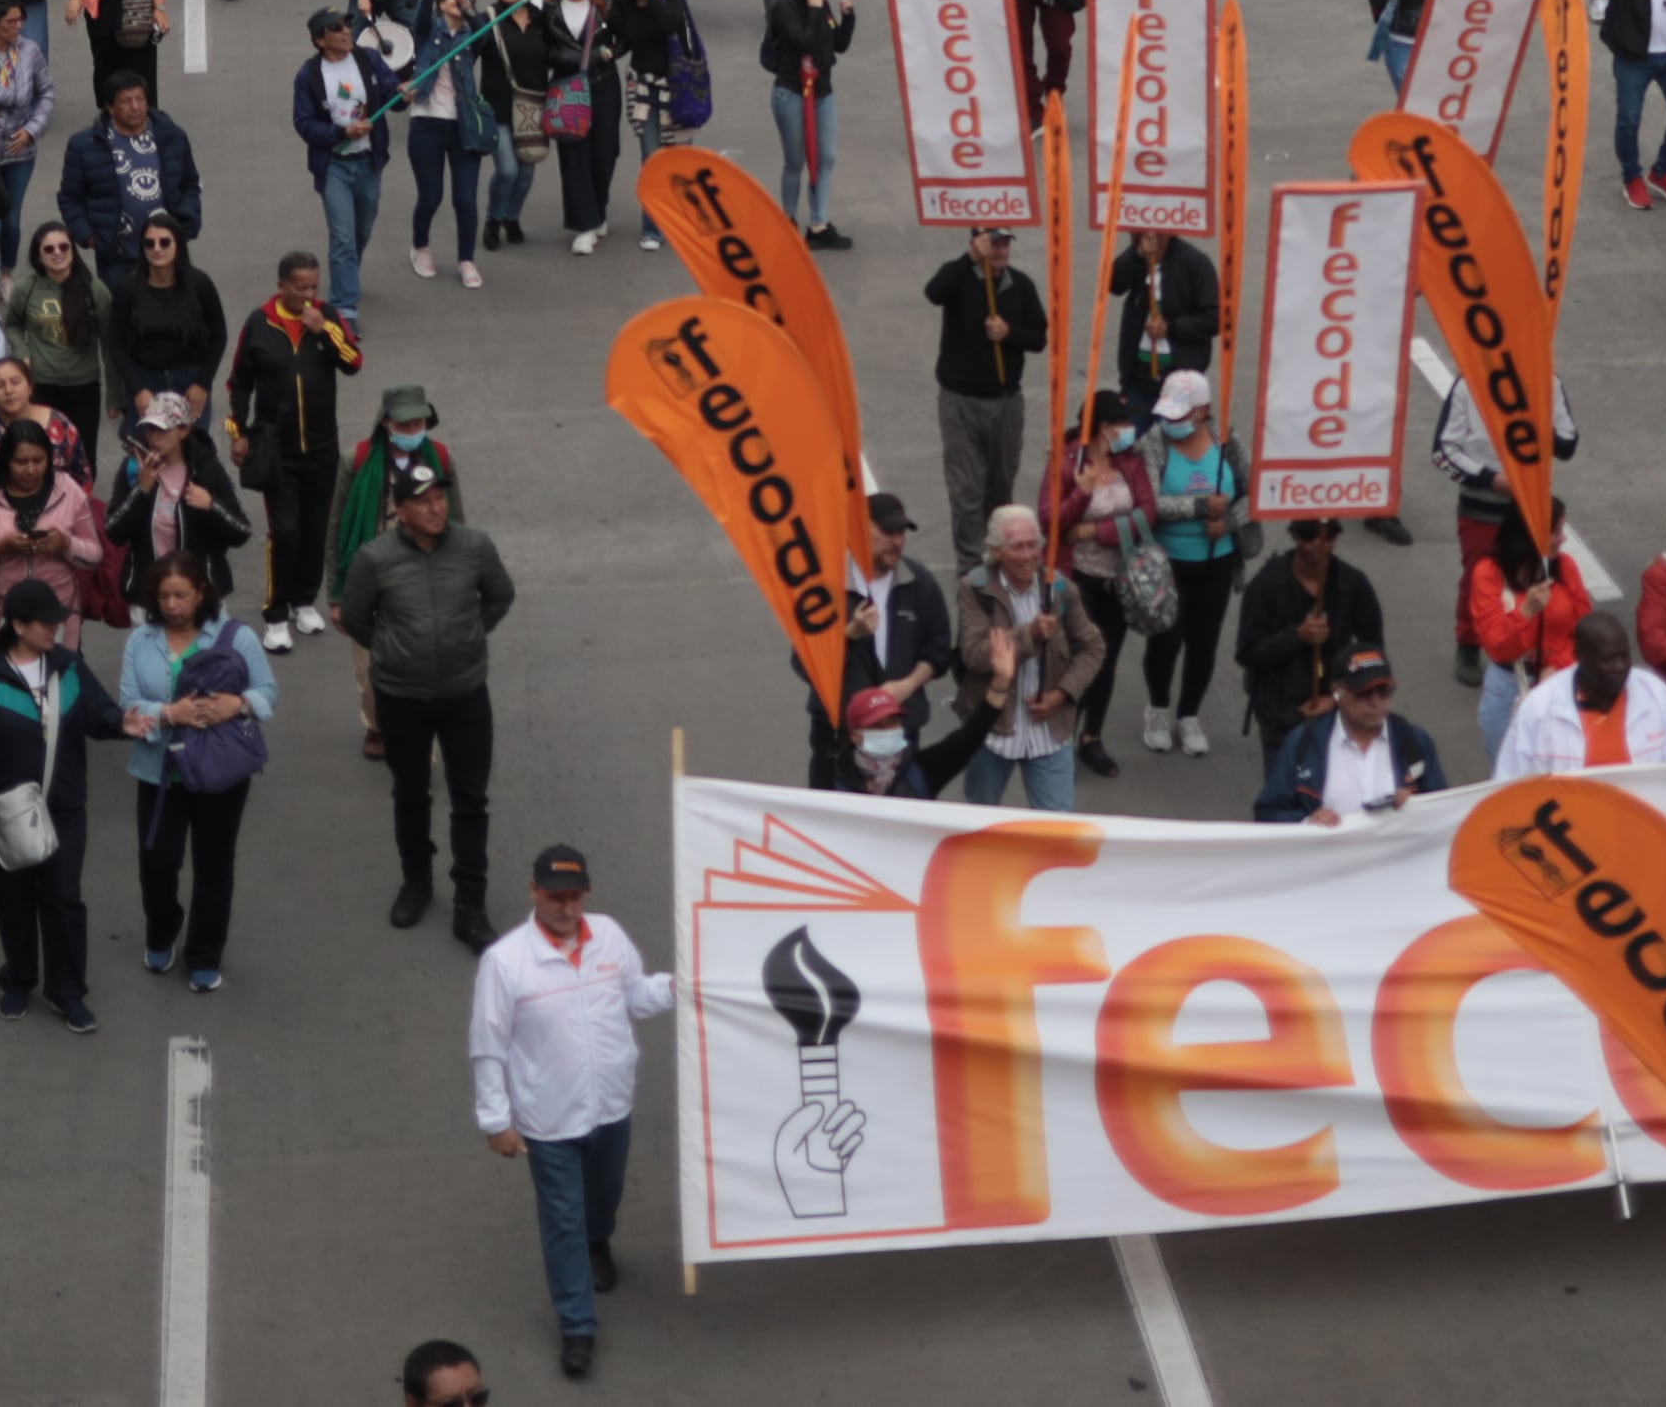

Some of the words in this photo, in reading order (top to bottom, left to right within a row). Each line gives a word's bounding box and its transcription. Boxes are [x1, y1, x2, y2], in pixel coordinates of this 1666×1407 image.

[938, 191, 1024, 216] fecode
[1307, 201, 1362, 449] fecode
[1412, 134, 1541, 466] fecode
[679, 316, 837, 636] fecode
[1279, 474, 1383, 506] fecode
